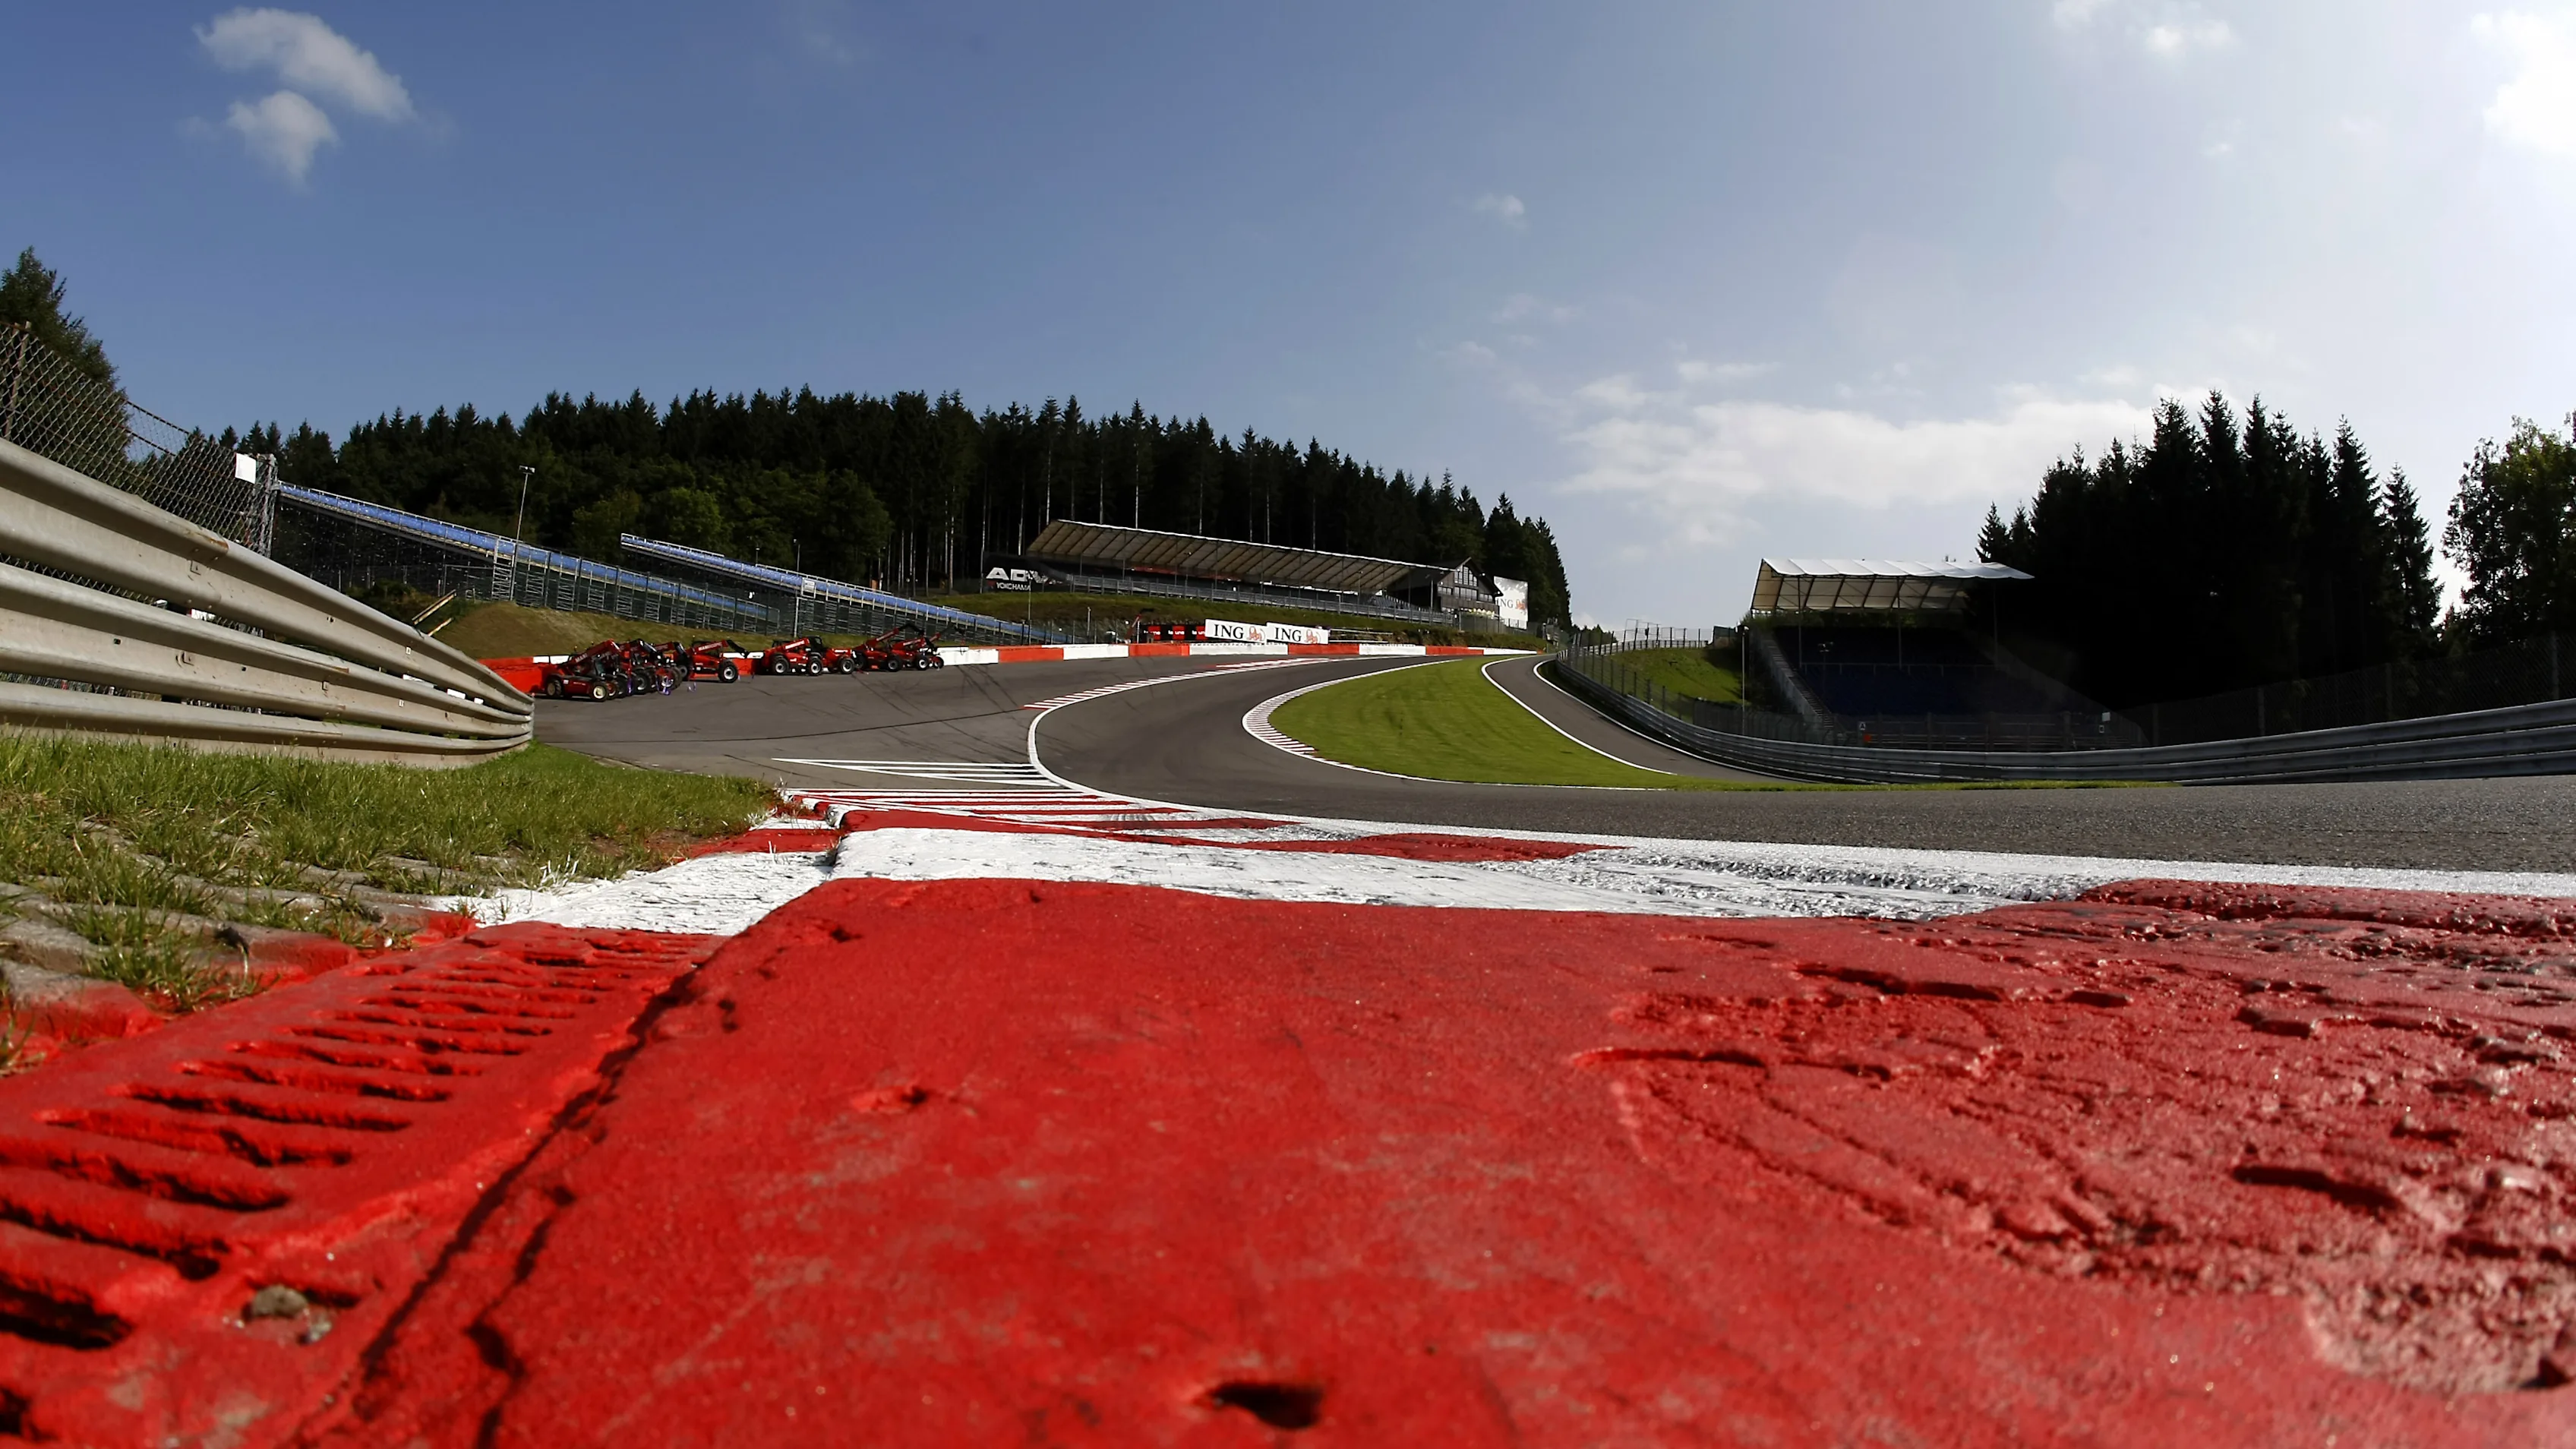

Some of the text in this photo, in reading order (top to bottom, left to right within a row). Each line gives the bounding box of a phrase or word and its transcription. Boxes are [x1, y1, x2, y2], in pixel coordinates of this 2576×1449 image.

[1496, 598, 1513, 608] ING
[1214, 624, 1243, 639] ING
[1275, 627, 1302, 641] ING
